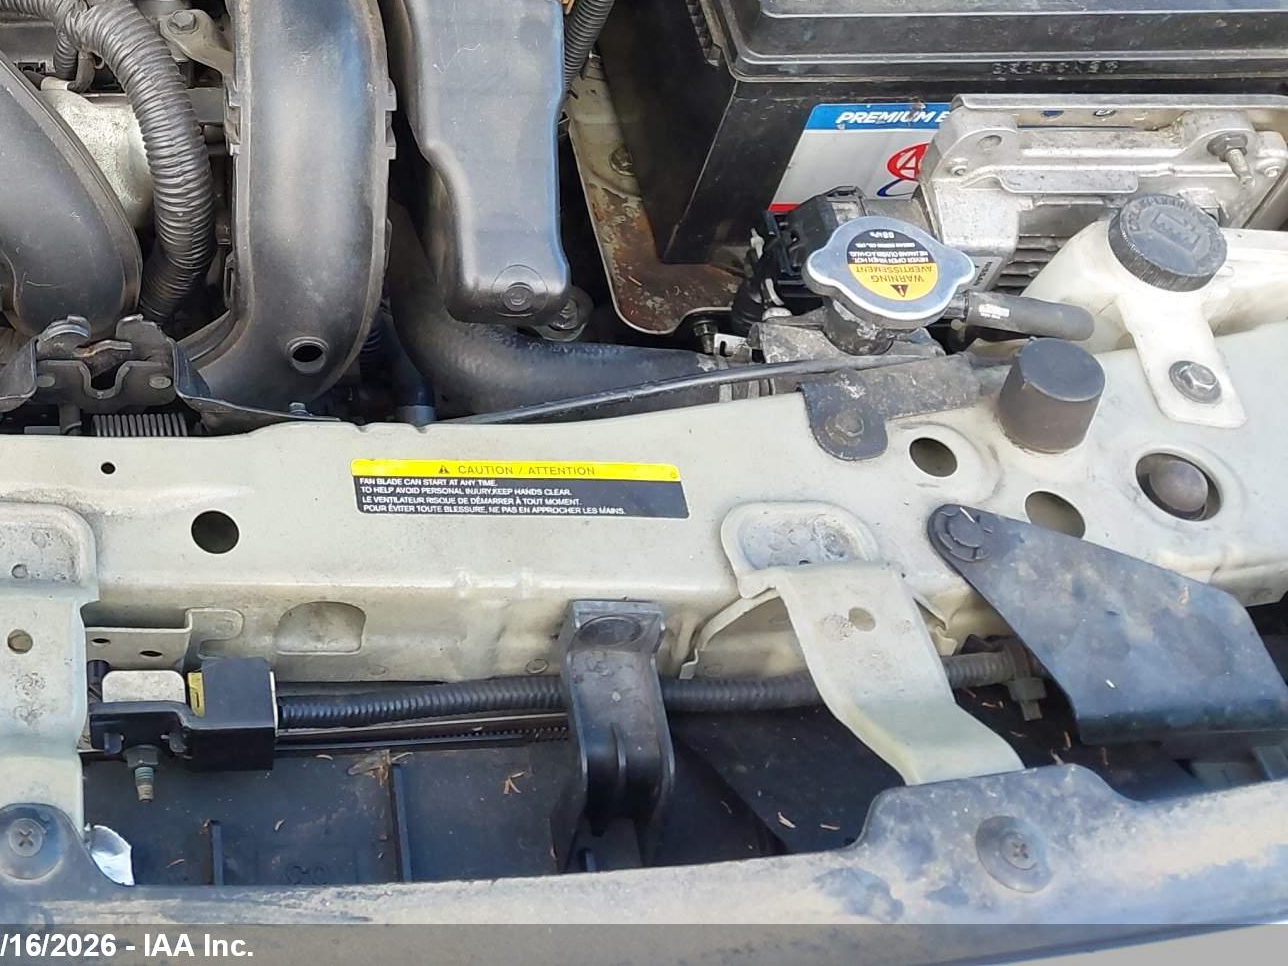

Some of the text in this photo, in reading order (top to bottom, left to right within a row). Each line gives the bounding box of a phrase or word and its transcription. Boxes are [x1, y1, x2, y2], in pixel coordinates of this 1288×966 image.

[835, 111, 933, 124] PREMIUM
[855, 265, 932, 273] AVERTISSEMENT
[870, 274, 925, 283] WARNING
[457, 465, 513, 475] CAUTION
[528, 466, 595, 476] ATTENTION
[514, 488, 543, 496] HANDS
[470, 496, 514, 505] DÉMARRER
[388, 504, 415, 512] ÉVITER
[502, 506, 517, 514] PAS
